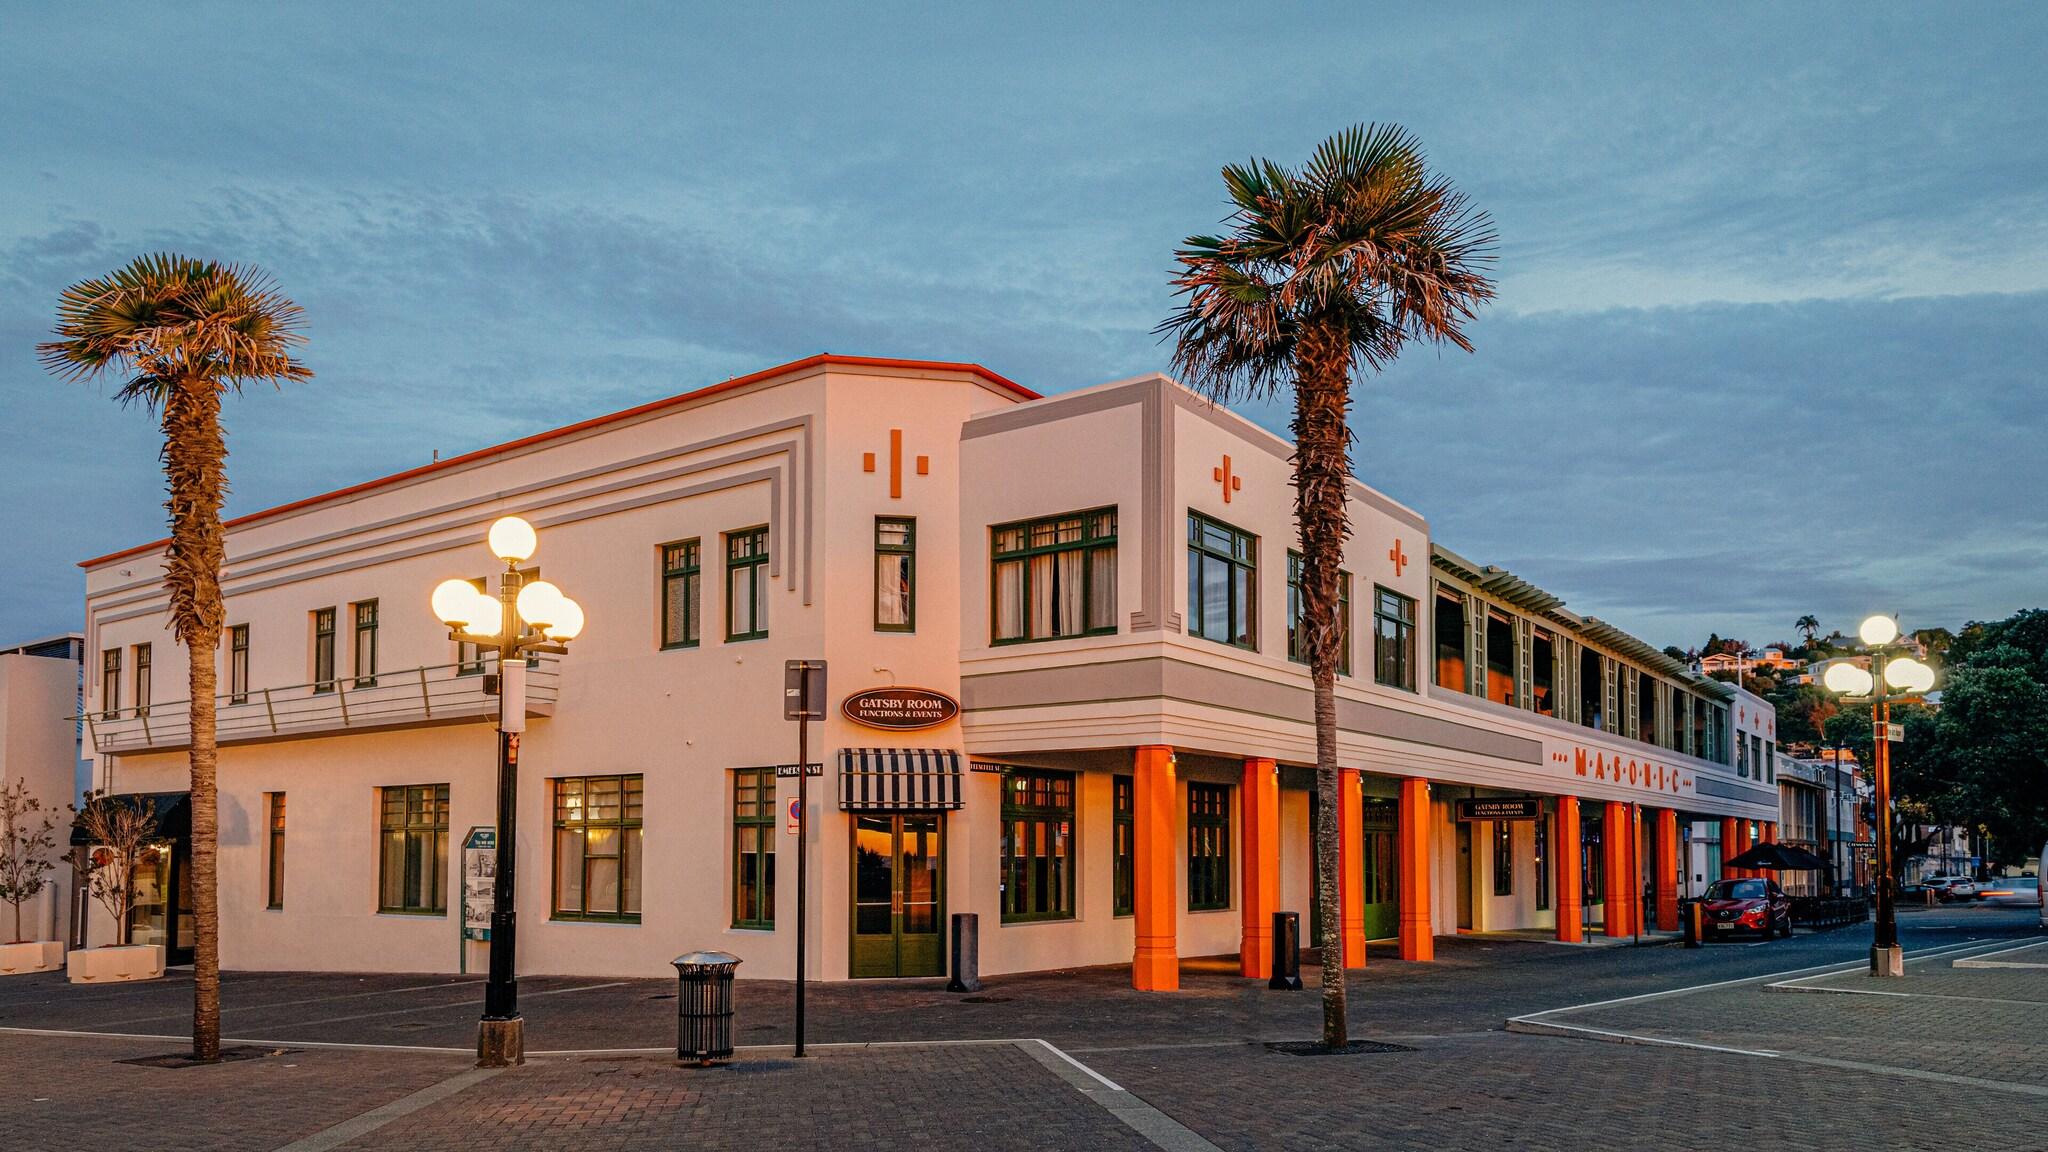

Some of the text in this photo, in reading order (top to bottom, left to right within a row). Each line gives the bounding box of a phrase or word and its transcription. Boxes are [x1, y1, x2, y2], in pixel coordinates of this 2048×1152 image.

[859, 698, 942, 709] GATSBY ROOM
[859, 710, 904, 718] FUNCTIONS
[778, 765, 820, 776] EMERSN ST
